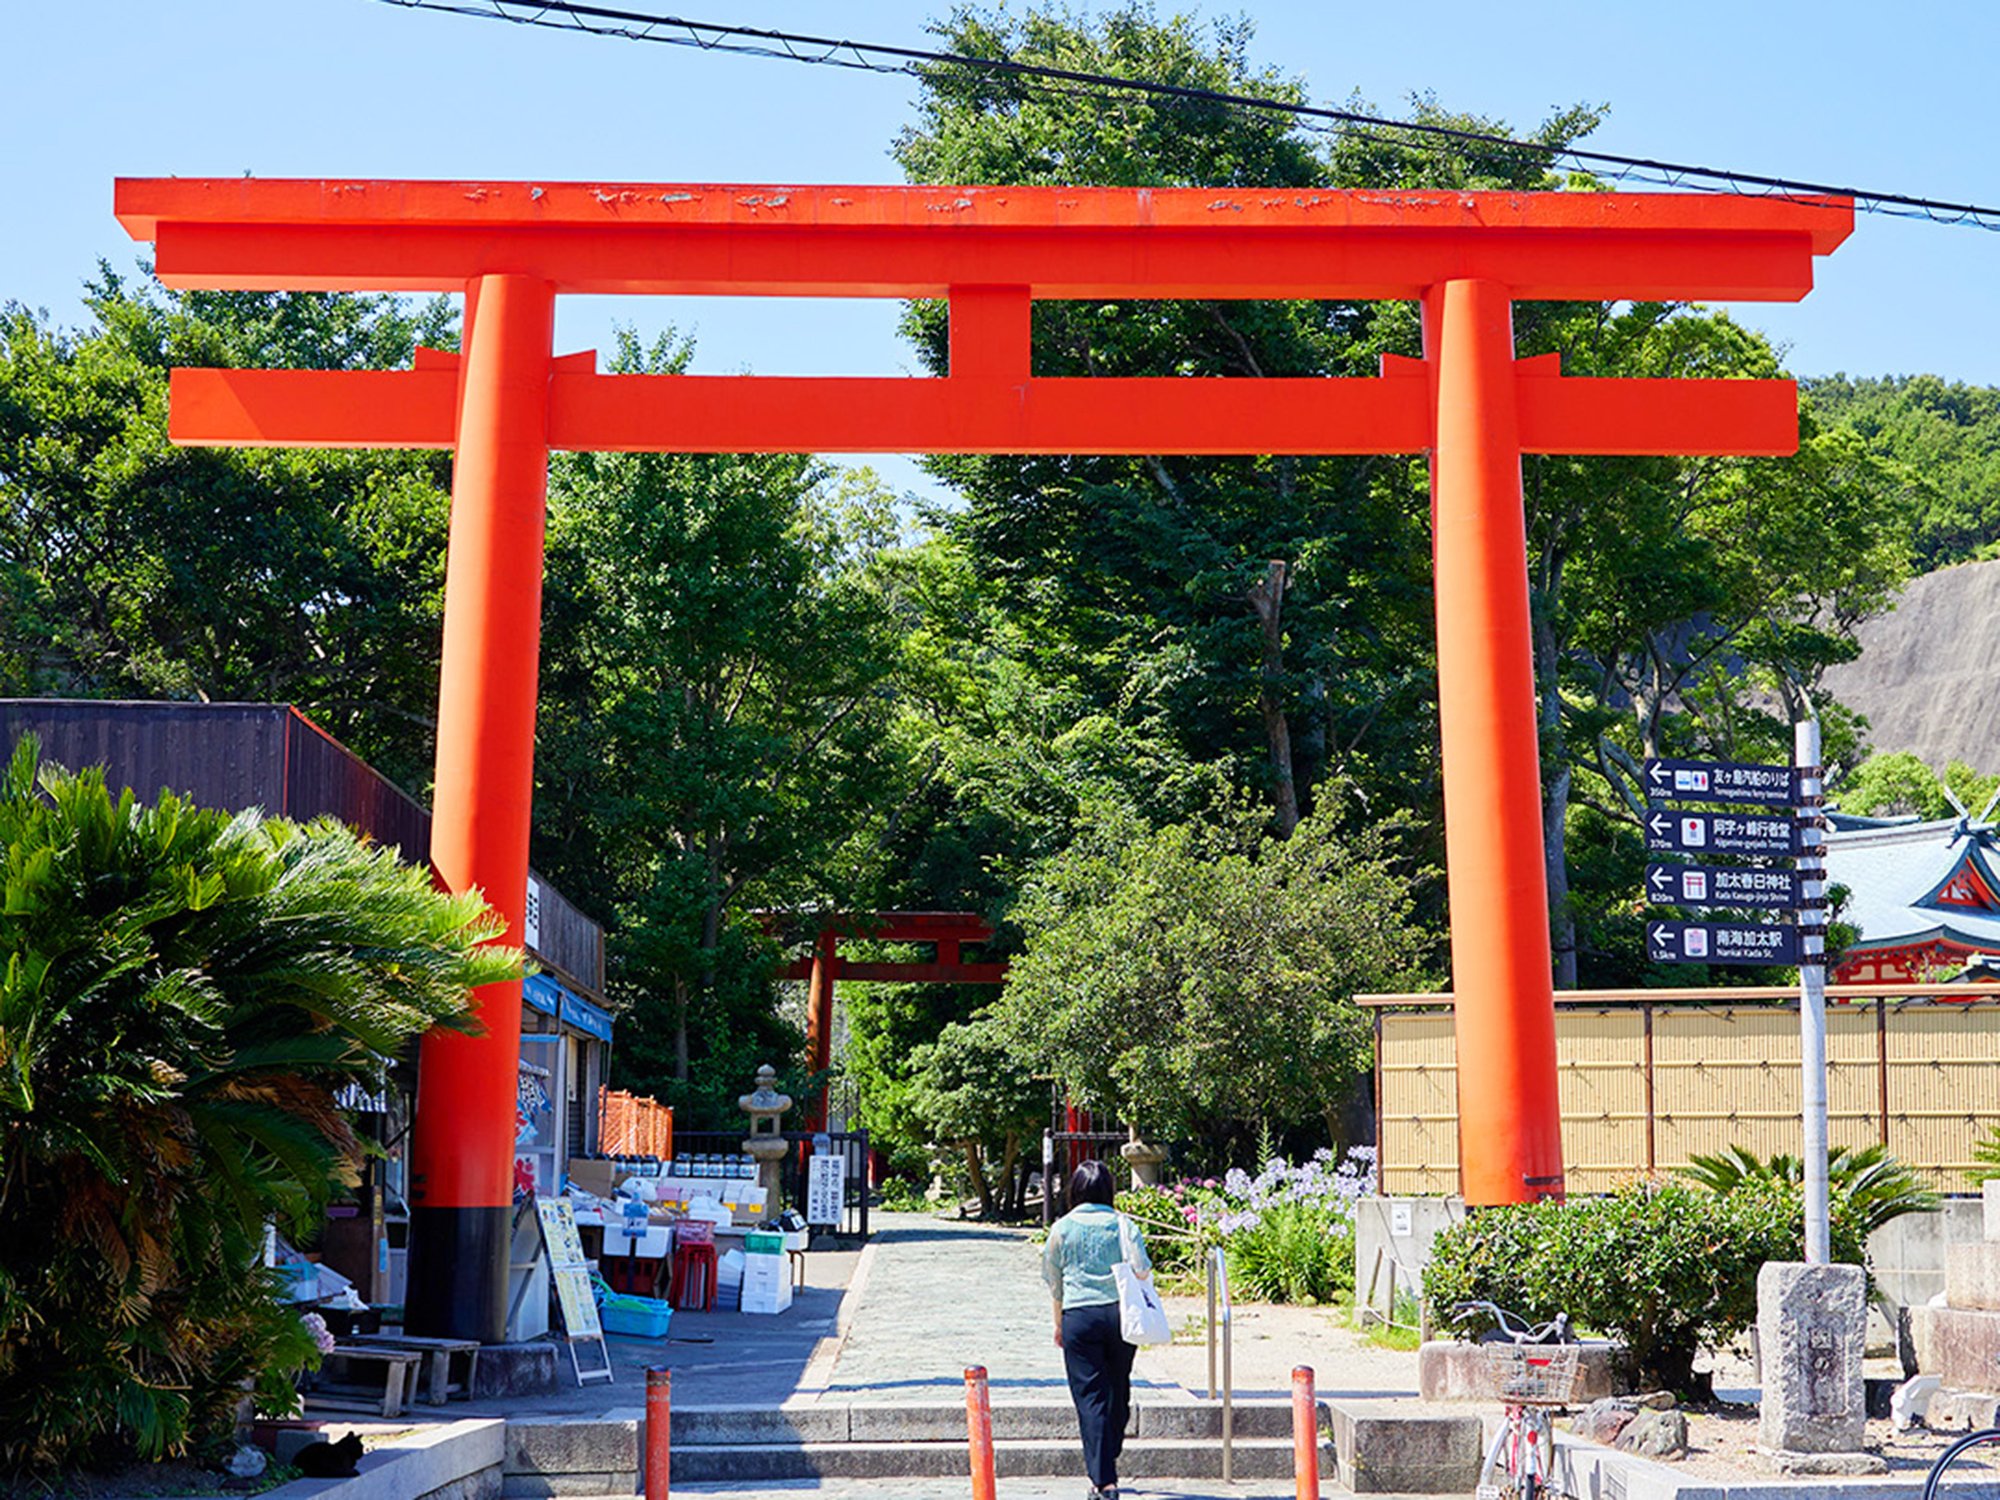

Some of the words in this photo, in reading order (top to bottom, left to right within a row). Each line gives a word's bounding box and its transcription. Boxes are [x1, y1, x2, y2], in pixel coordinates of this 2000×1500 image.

[1650, 787, 1673, 797] 350m
[1650, 839, 1673, 849] 370m
[1715, 872, 1791, 890] 加太春日神社
[1651, 893, 1675, 903] 820m
[1715, 891, 1731, 900] Kada
[1770, 893, 1789, 902] Shrine
[1716, 929, 1783, 947] 南海加太駅
[1716, 948, 1741, 957] Nankai
[1744, 948, 1762, 958] Kada
